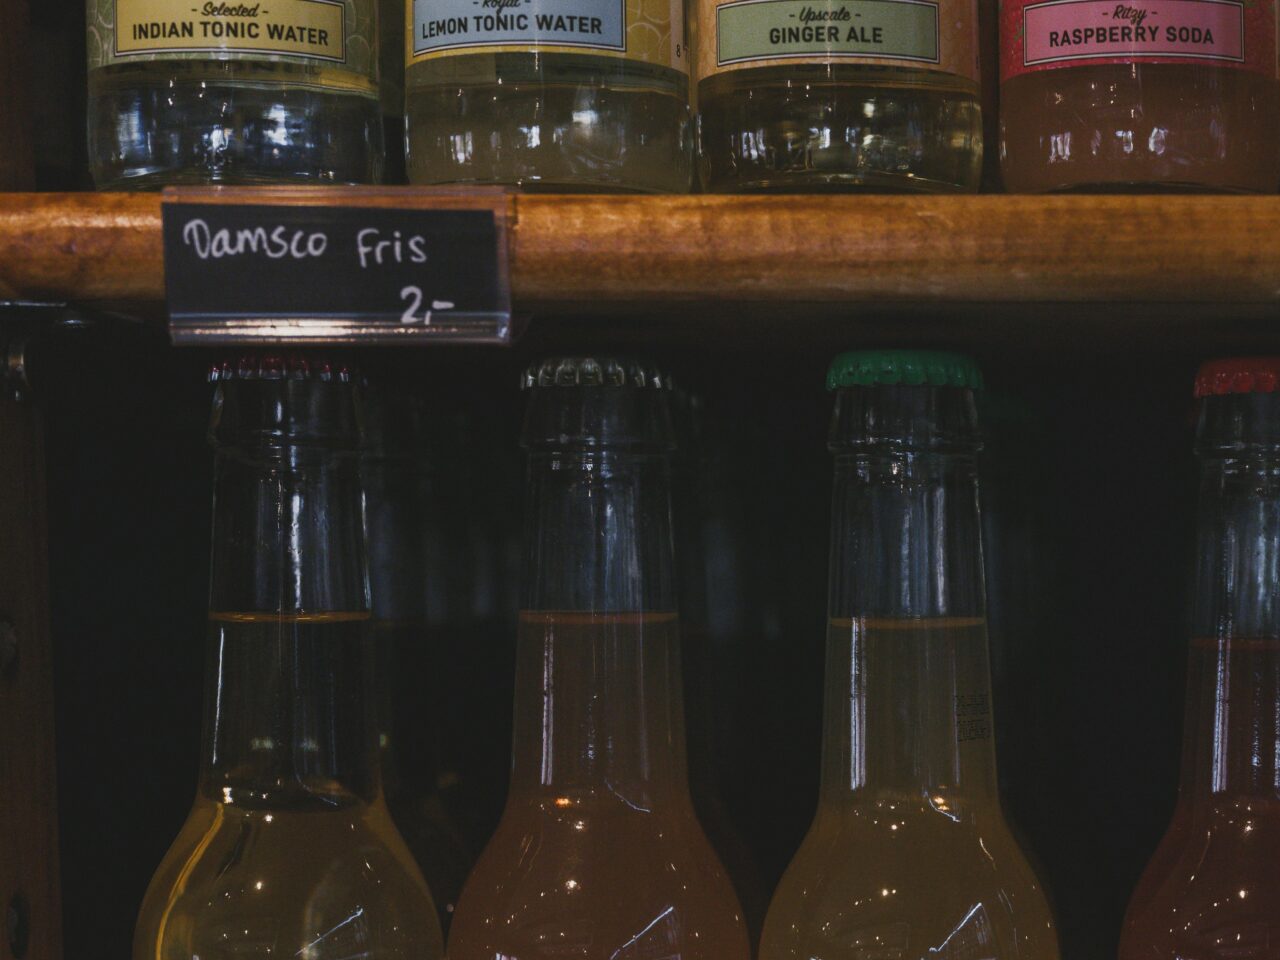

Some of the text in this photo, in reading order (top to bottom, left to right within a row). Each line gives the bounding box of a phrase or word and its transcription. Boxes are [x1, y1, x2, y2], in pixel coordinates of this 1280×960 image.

[201, 1, 260, 17] Selected
[799, 6, 851, 25] Upscale
[1112, 5, 1145, 28] Ritzy
[133, 21, 329, 46] INDIAN TONIC WATER
[422, 15, 602, 39] LEMON TONIC WATER
[769, 26, 883, 45] GINGER ALE
[1049, 25, 1214, 48] RASPBERRY SODA
[183, 219, 328, 260] Damsco
